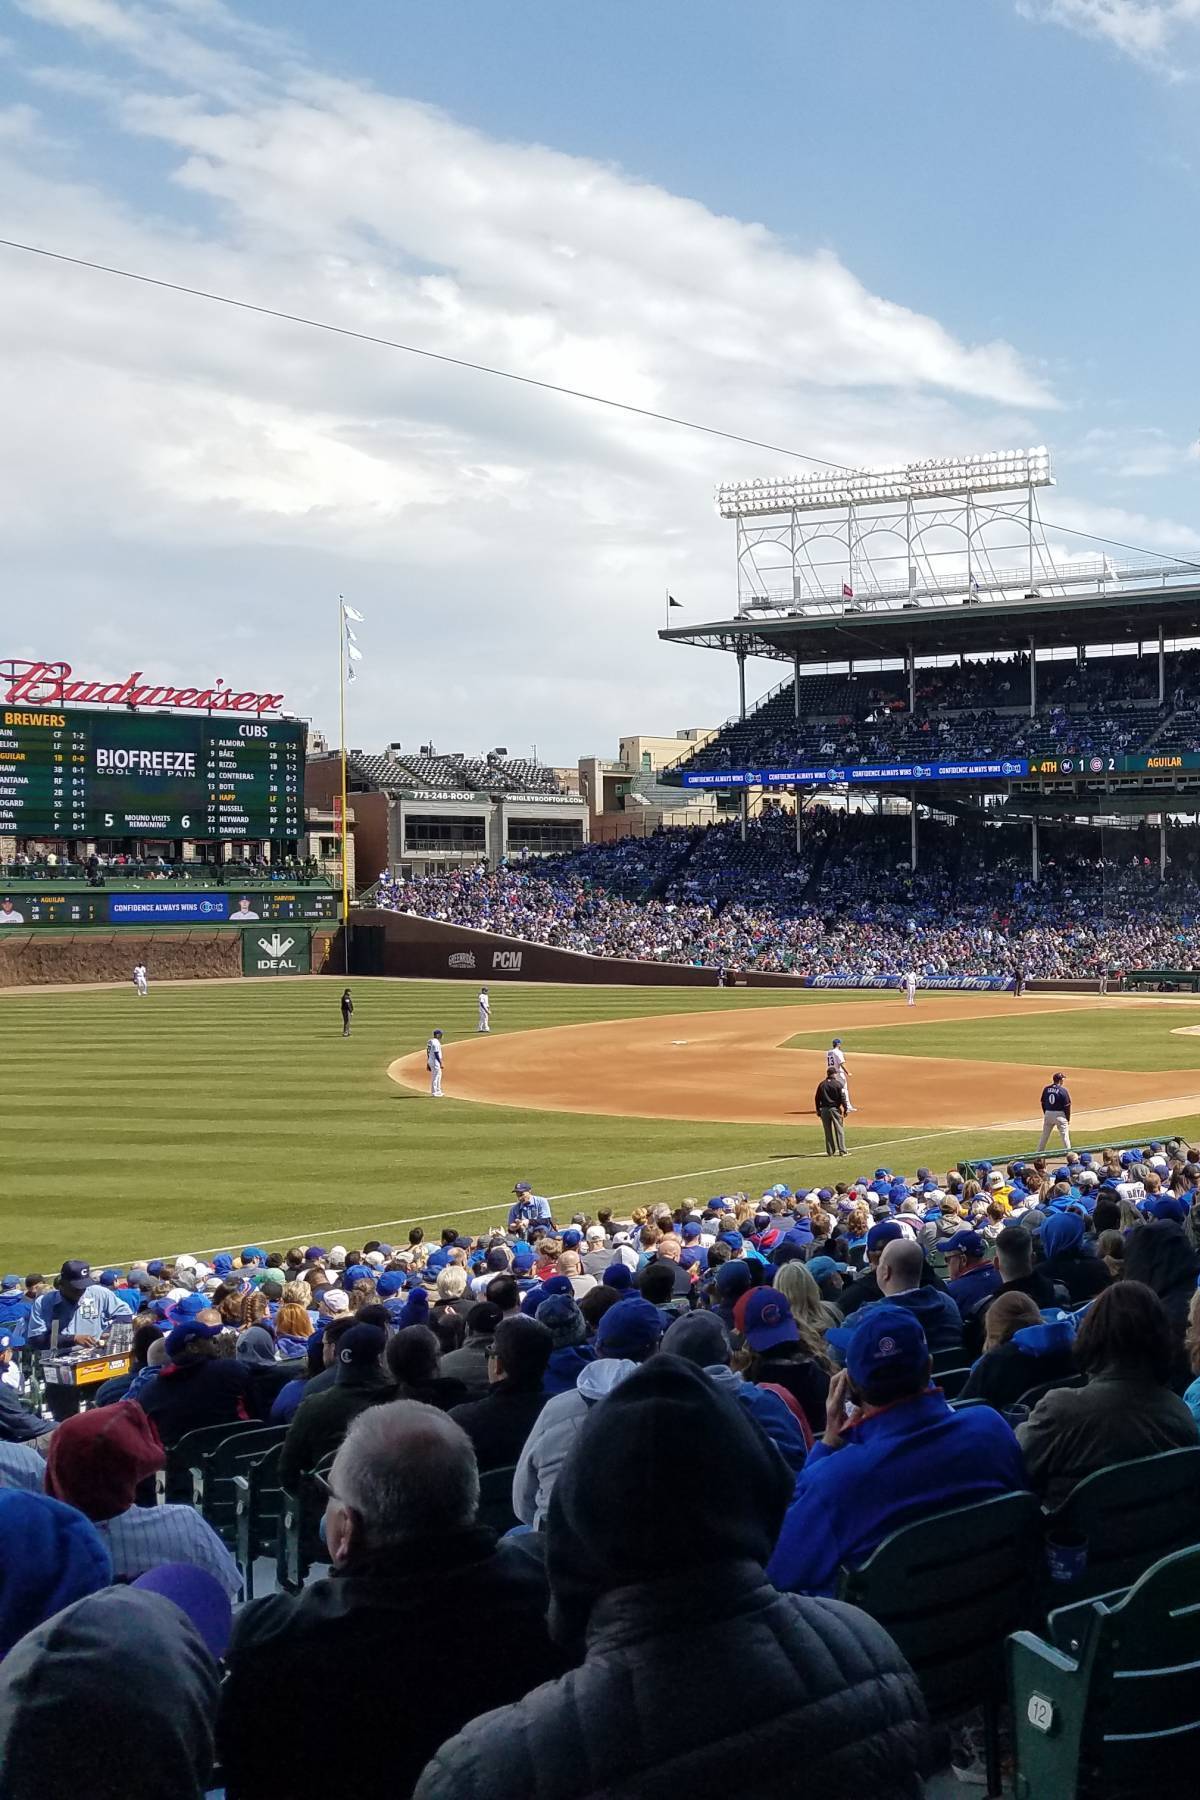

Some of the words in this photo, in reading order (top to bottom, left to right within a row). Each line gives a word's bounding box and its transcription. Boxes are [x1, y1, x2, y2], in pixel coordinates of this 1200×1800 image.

[0, 660, 284, 712] Budweiser
[4, 712, 66, 727] BREWERS
[238, 724, 268, 737] CUBS
[96, 748, 196, 770] BIOFREEZE
[219, 749, 234, 758] BÁEZ
[1040, 762, 1056, 772] 4TH
[1078, 760, 1084, 772] 1
[1108, 758, 1114, 770] 2
[1147, 756, 1182, 768] AGUILAR
[414, 792, 475, 800] 773-248-ROOF
[104, 814, 114, 827] 5
[181, 816, 190, 828] 6
[114, 904, 154, 912] CONFIDENCE
[258, 960, 296, 968] IDEAL
[492, 952, 522, 968] PCM
[812, 975, 860, 988] Reynolds
[860, 976, 887, 989] Wrap
[915, 976, 960, 990] Reynolds
[960, 976, 990, 990] Wrap
[828, 1056, 834, 1066] 13
[1048, 1093, 1056, 1104] 0
[1034, 1702, 1046, 1724] 12
